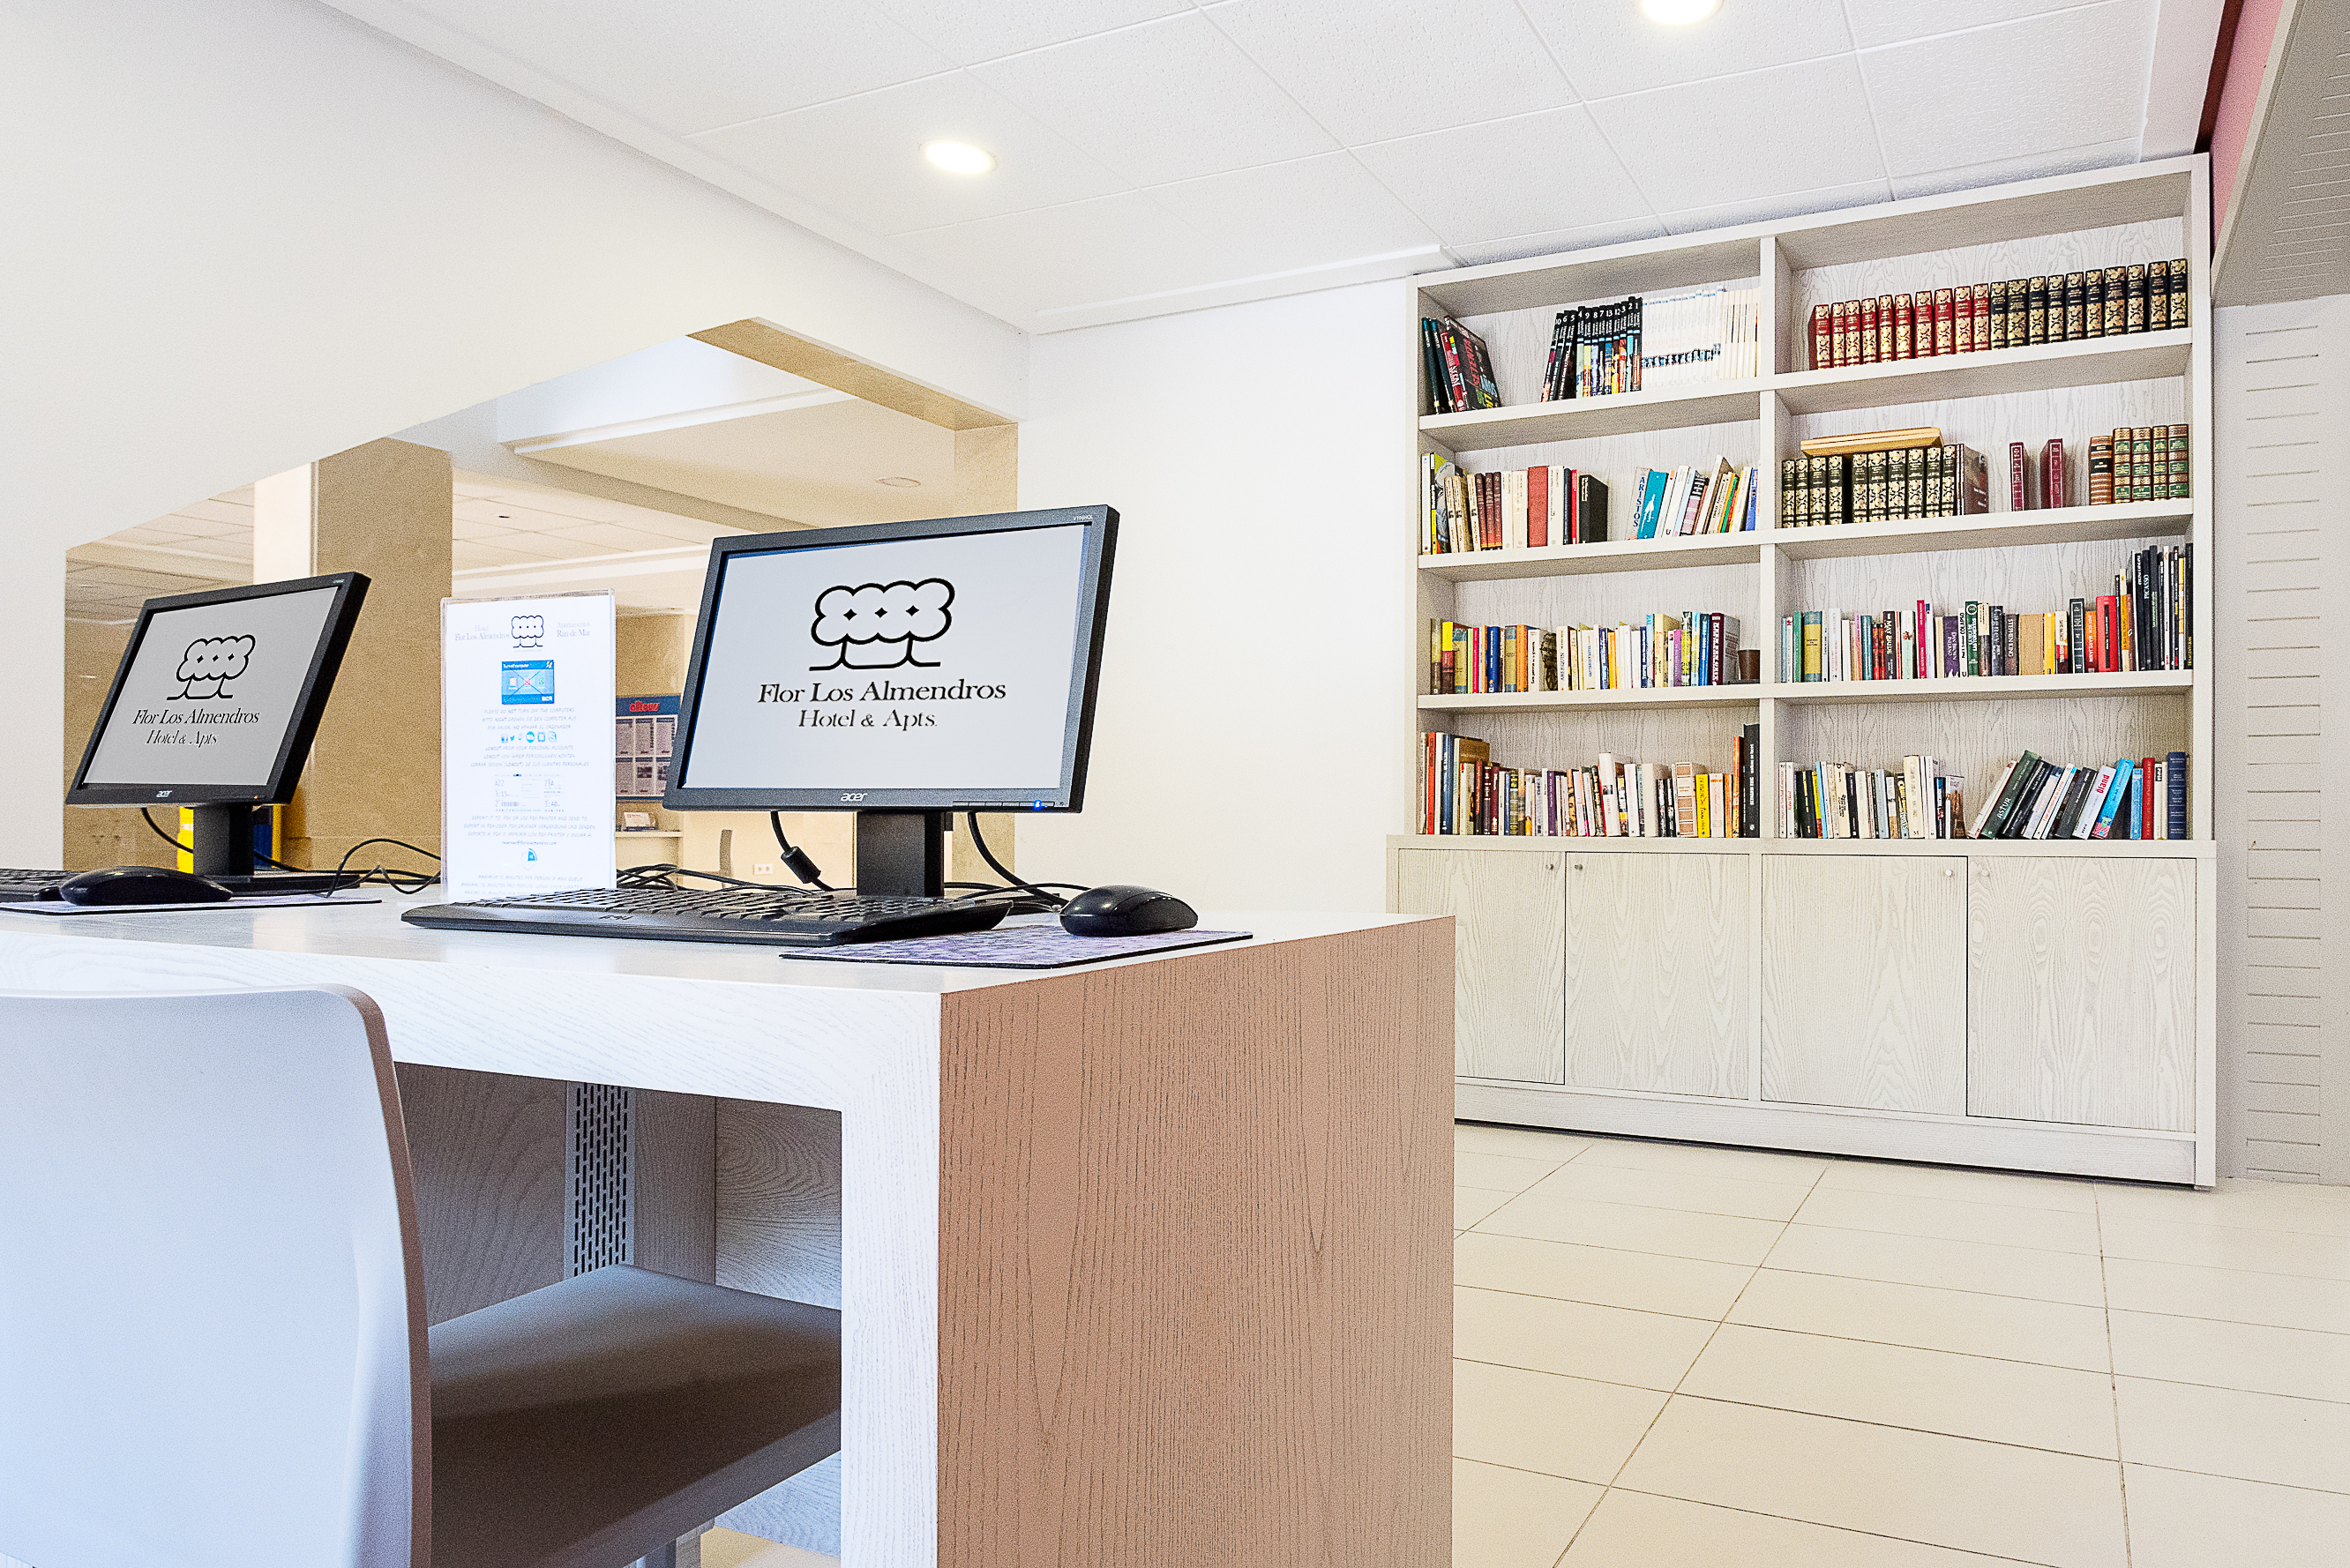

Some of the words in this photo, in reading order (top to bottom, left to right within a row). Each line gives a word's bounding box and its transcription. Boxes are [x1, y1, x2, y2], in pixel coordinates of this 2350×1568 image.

[1633, 476, 1645, 527] ARISTOS
[758, 683, 805, 704] Flor
[810, 682, 854, 702] Los
[860, 678, 1007, 701] Almendros
[132, 709, 159, 725] Flor
[159, 709, 183, 725] Los
[184, 707, 260, 724] Almendros
[797, 709, 856, 728] Hotel
[861, 713, 875, 728] &
[882, 709, 938, 731] Apts.
[146, 730, 178, 744] Hotel
[178, 733, 187, 744] &
[840, 791, 869, 803] acer
